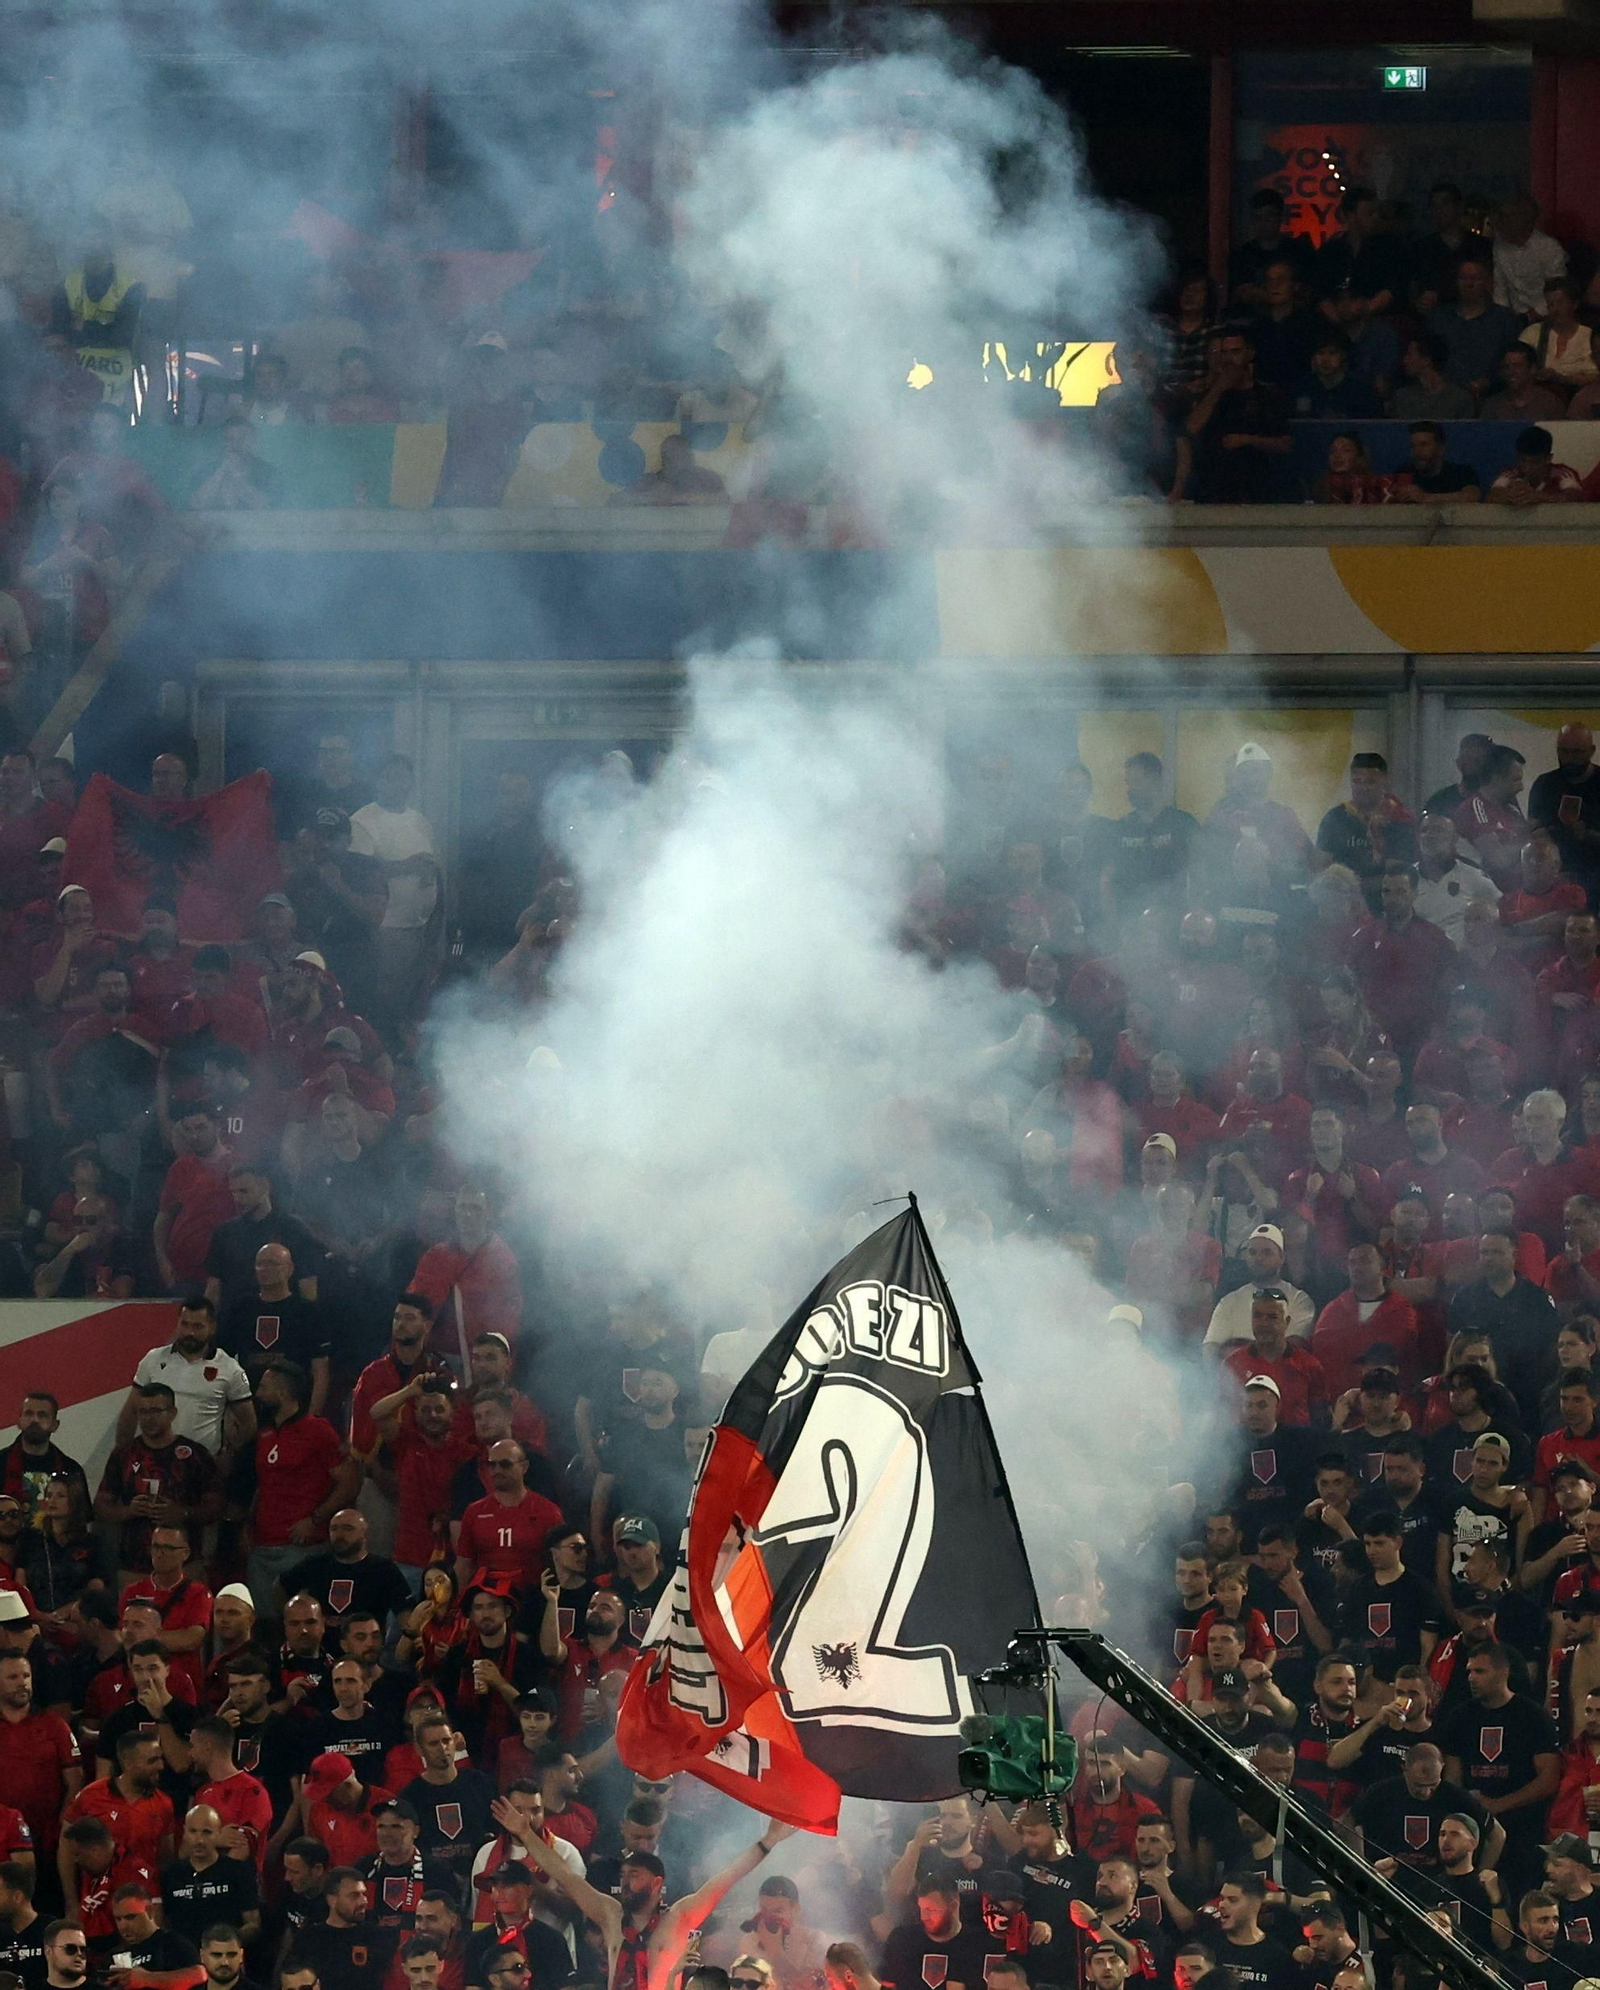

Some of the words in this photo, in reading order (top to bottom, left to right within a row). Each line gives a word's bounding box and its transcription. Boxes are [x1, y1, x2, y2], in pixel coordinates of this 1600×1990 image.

[227, 1116, 244, 1134] 10
[267, 1443, 279, 1464] 6
[497, 1527, 512, 1547] 11
[750, 1372, 975, 1737] 2
[1222, 1673, 1234, 1686] NY
